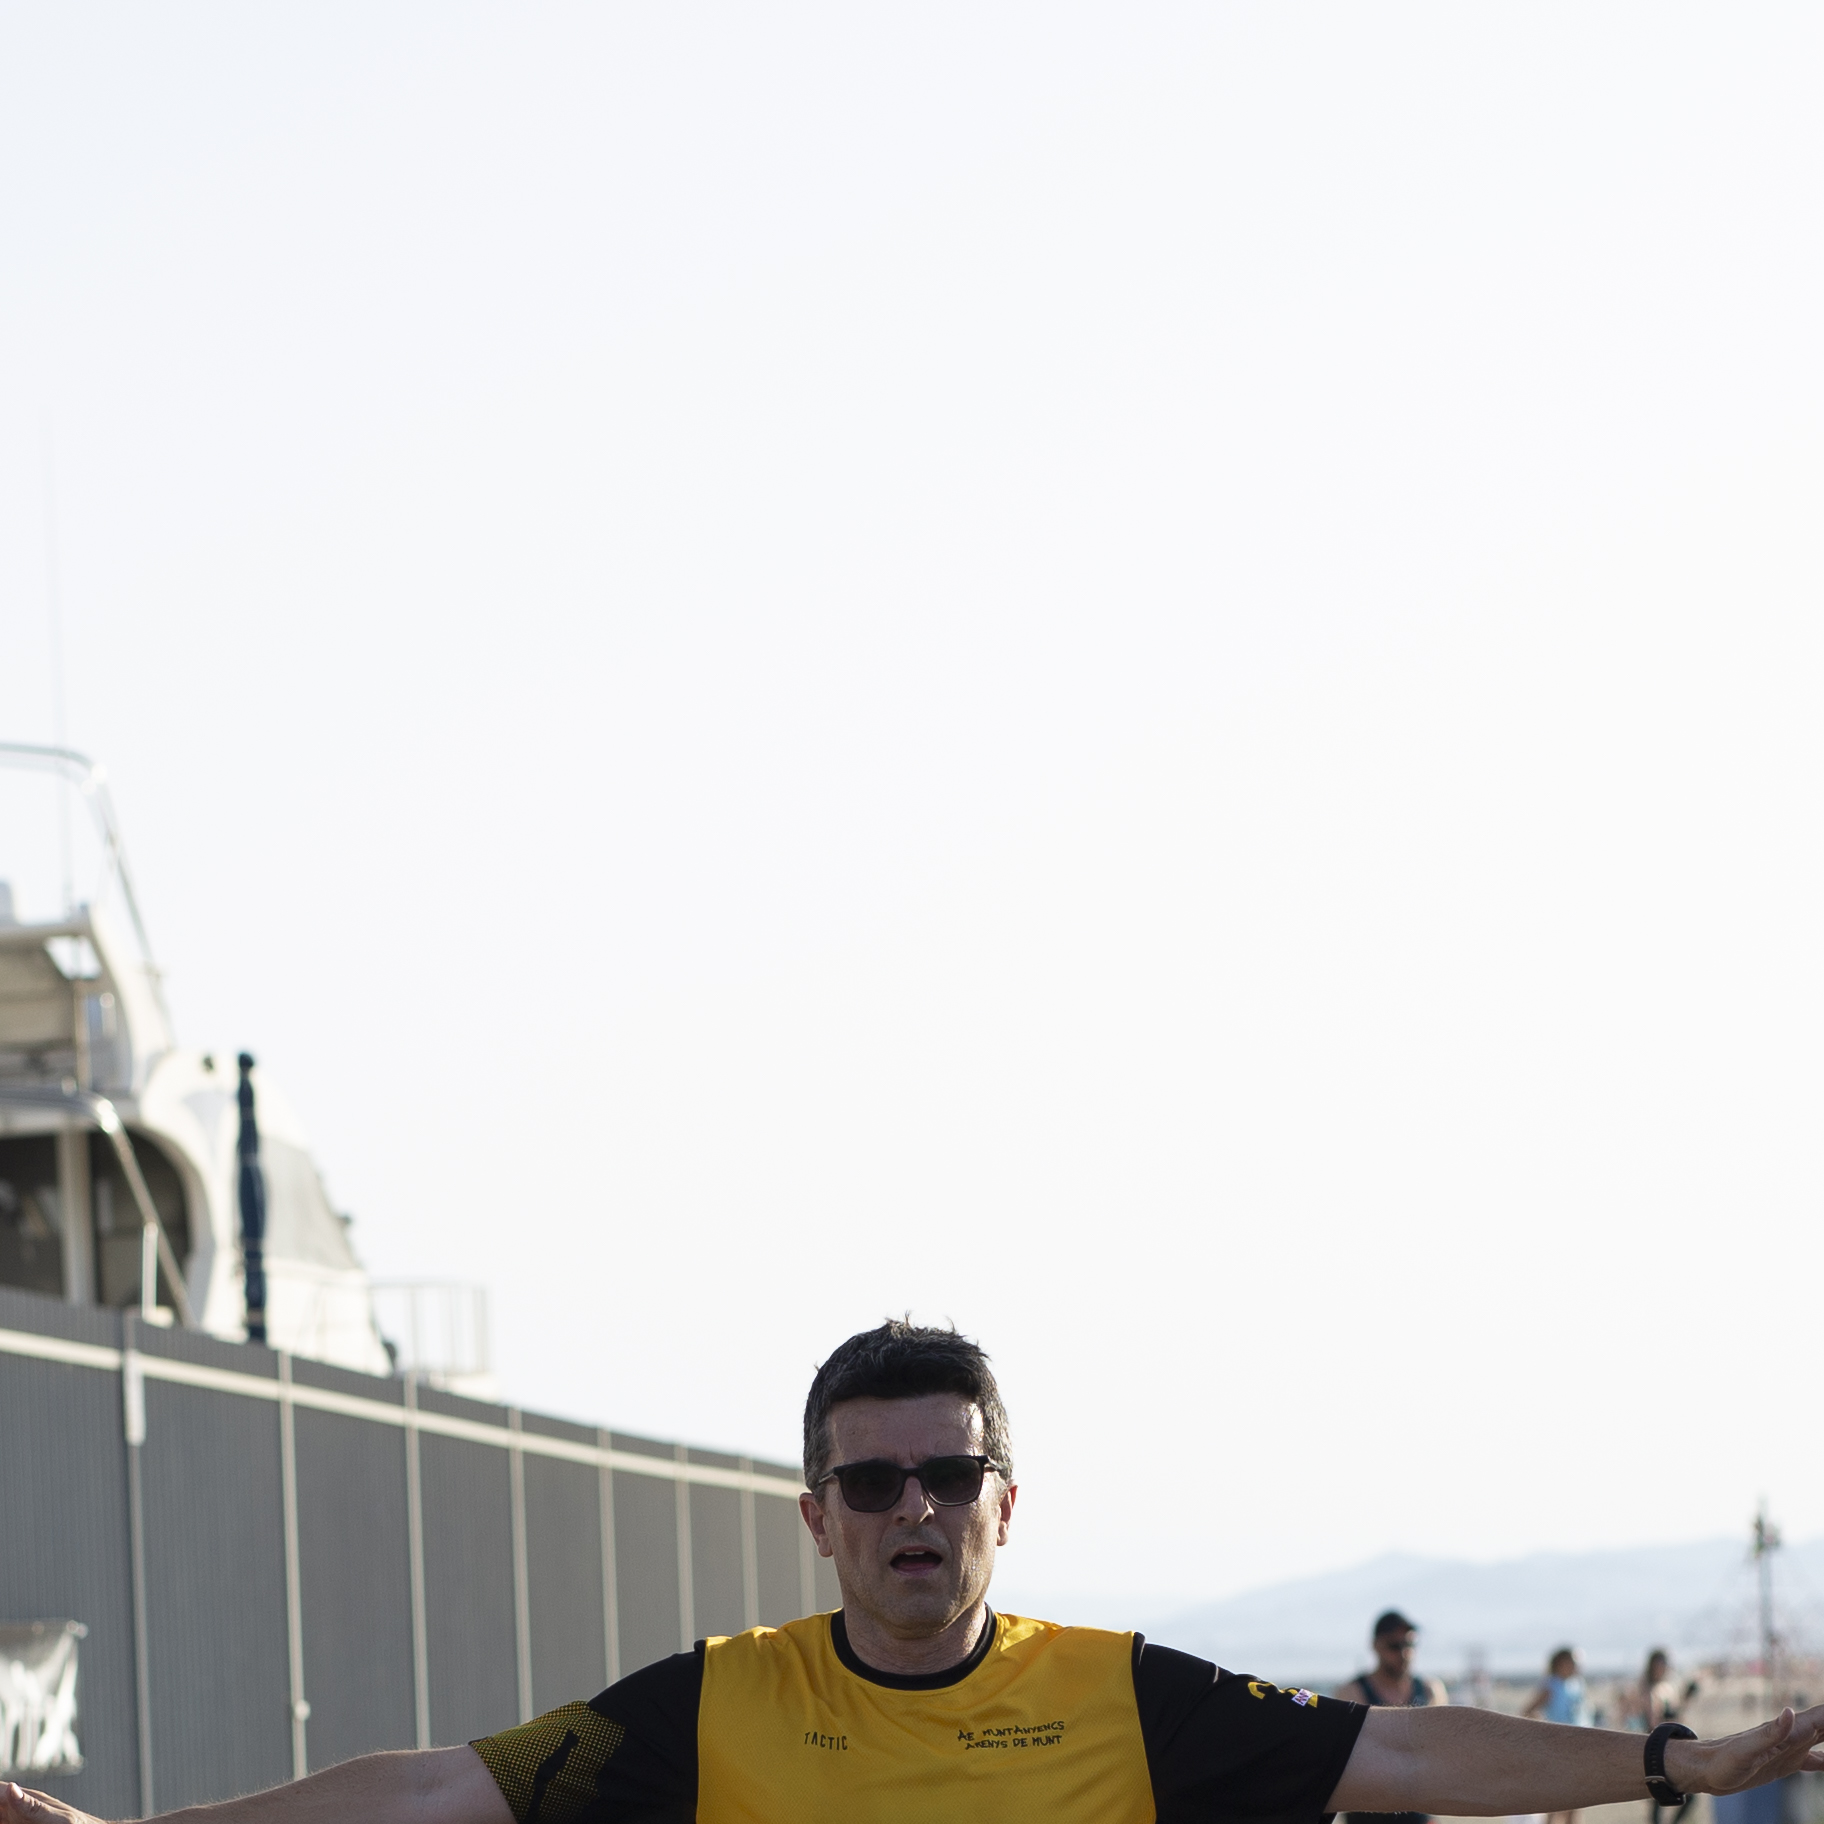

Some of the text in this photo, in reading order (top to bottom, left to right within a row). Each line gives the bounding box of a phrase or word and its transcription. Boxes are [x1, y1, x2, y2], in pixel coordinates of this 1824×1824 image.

[804, 1731, 848, 1751] TACTIC
[957, 1720, 1065, 1742] AE MUNTANYENCS
[965, 1734, 1063, 1751] ARENYS DE MUNT
